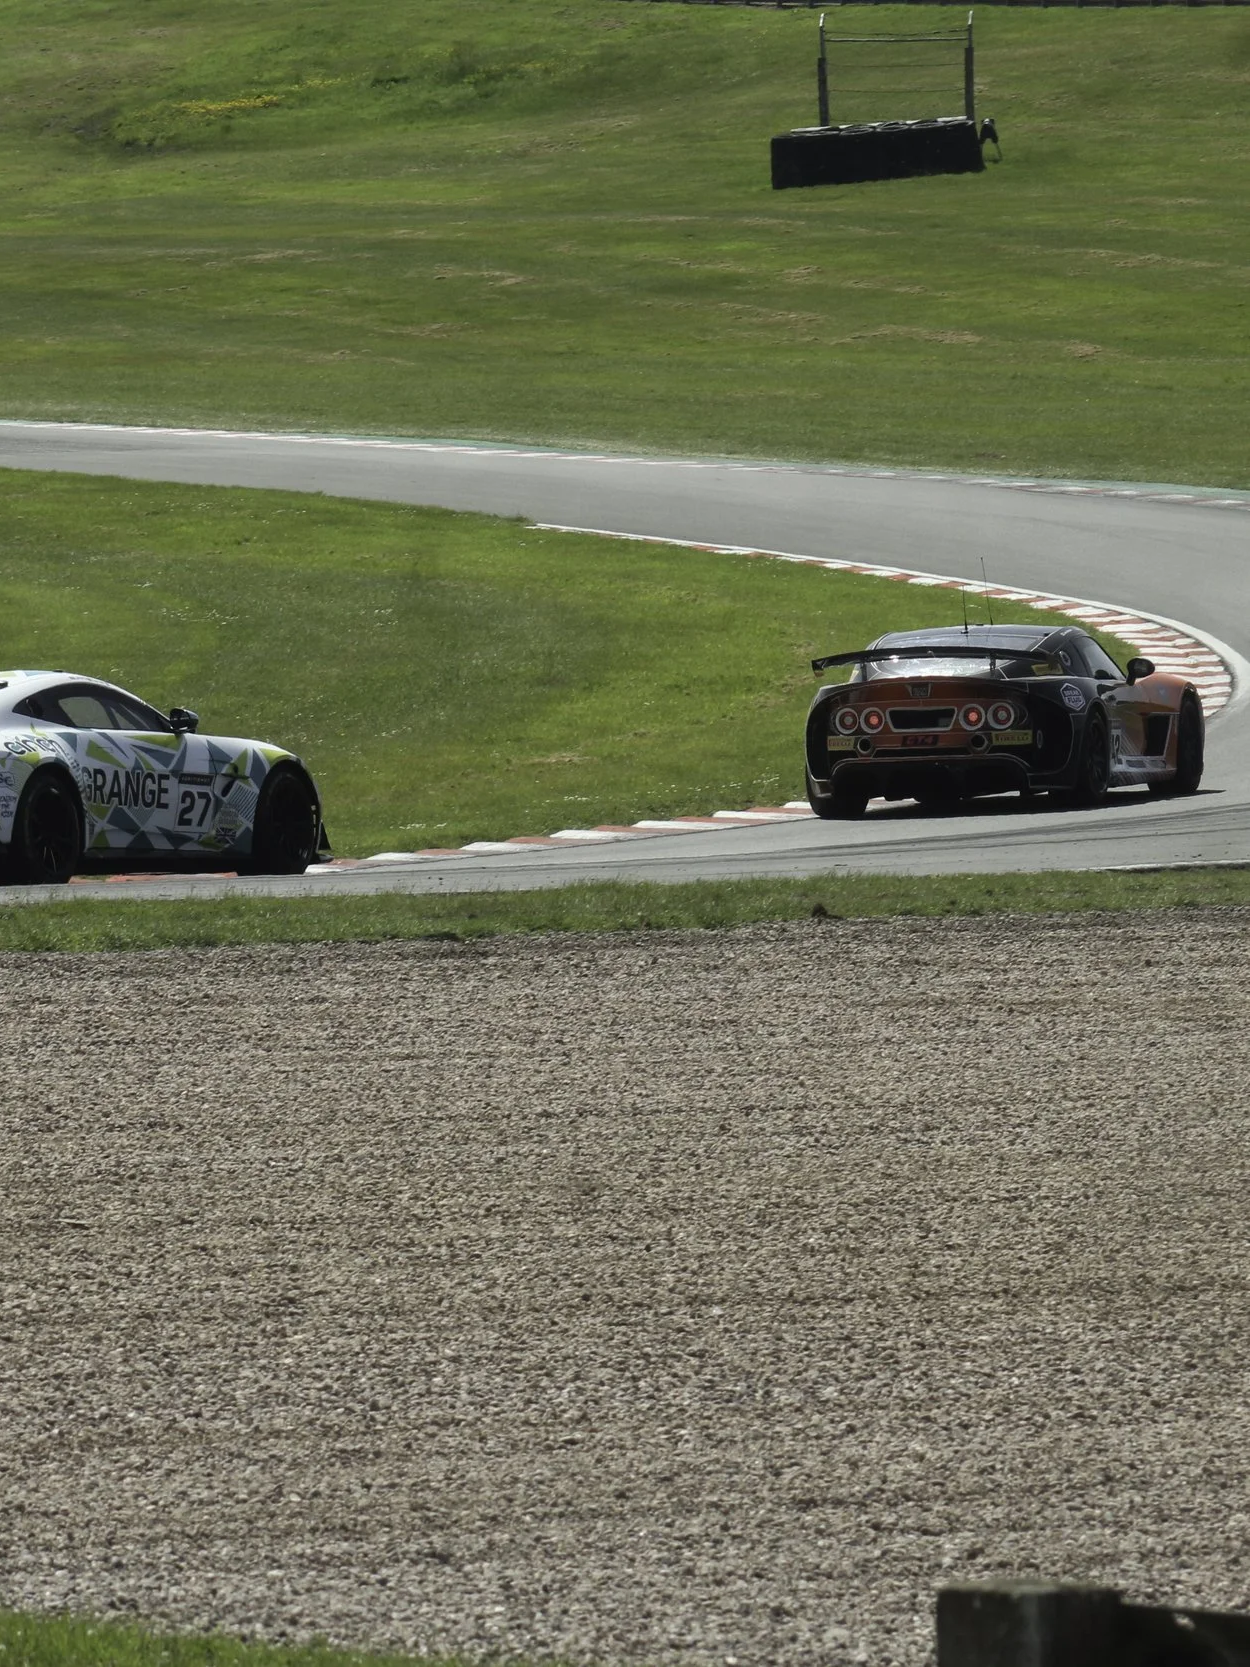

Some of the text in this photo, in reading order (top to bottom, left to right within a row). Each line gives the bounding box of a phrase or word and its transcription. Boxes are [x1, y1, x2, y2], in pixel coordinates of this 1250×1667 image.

[4, 736, 68, 758] cinch
[81, 767, 170, 809] GRANGE
[178, 790, 212, 827] 27
